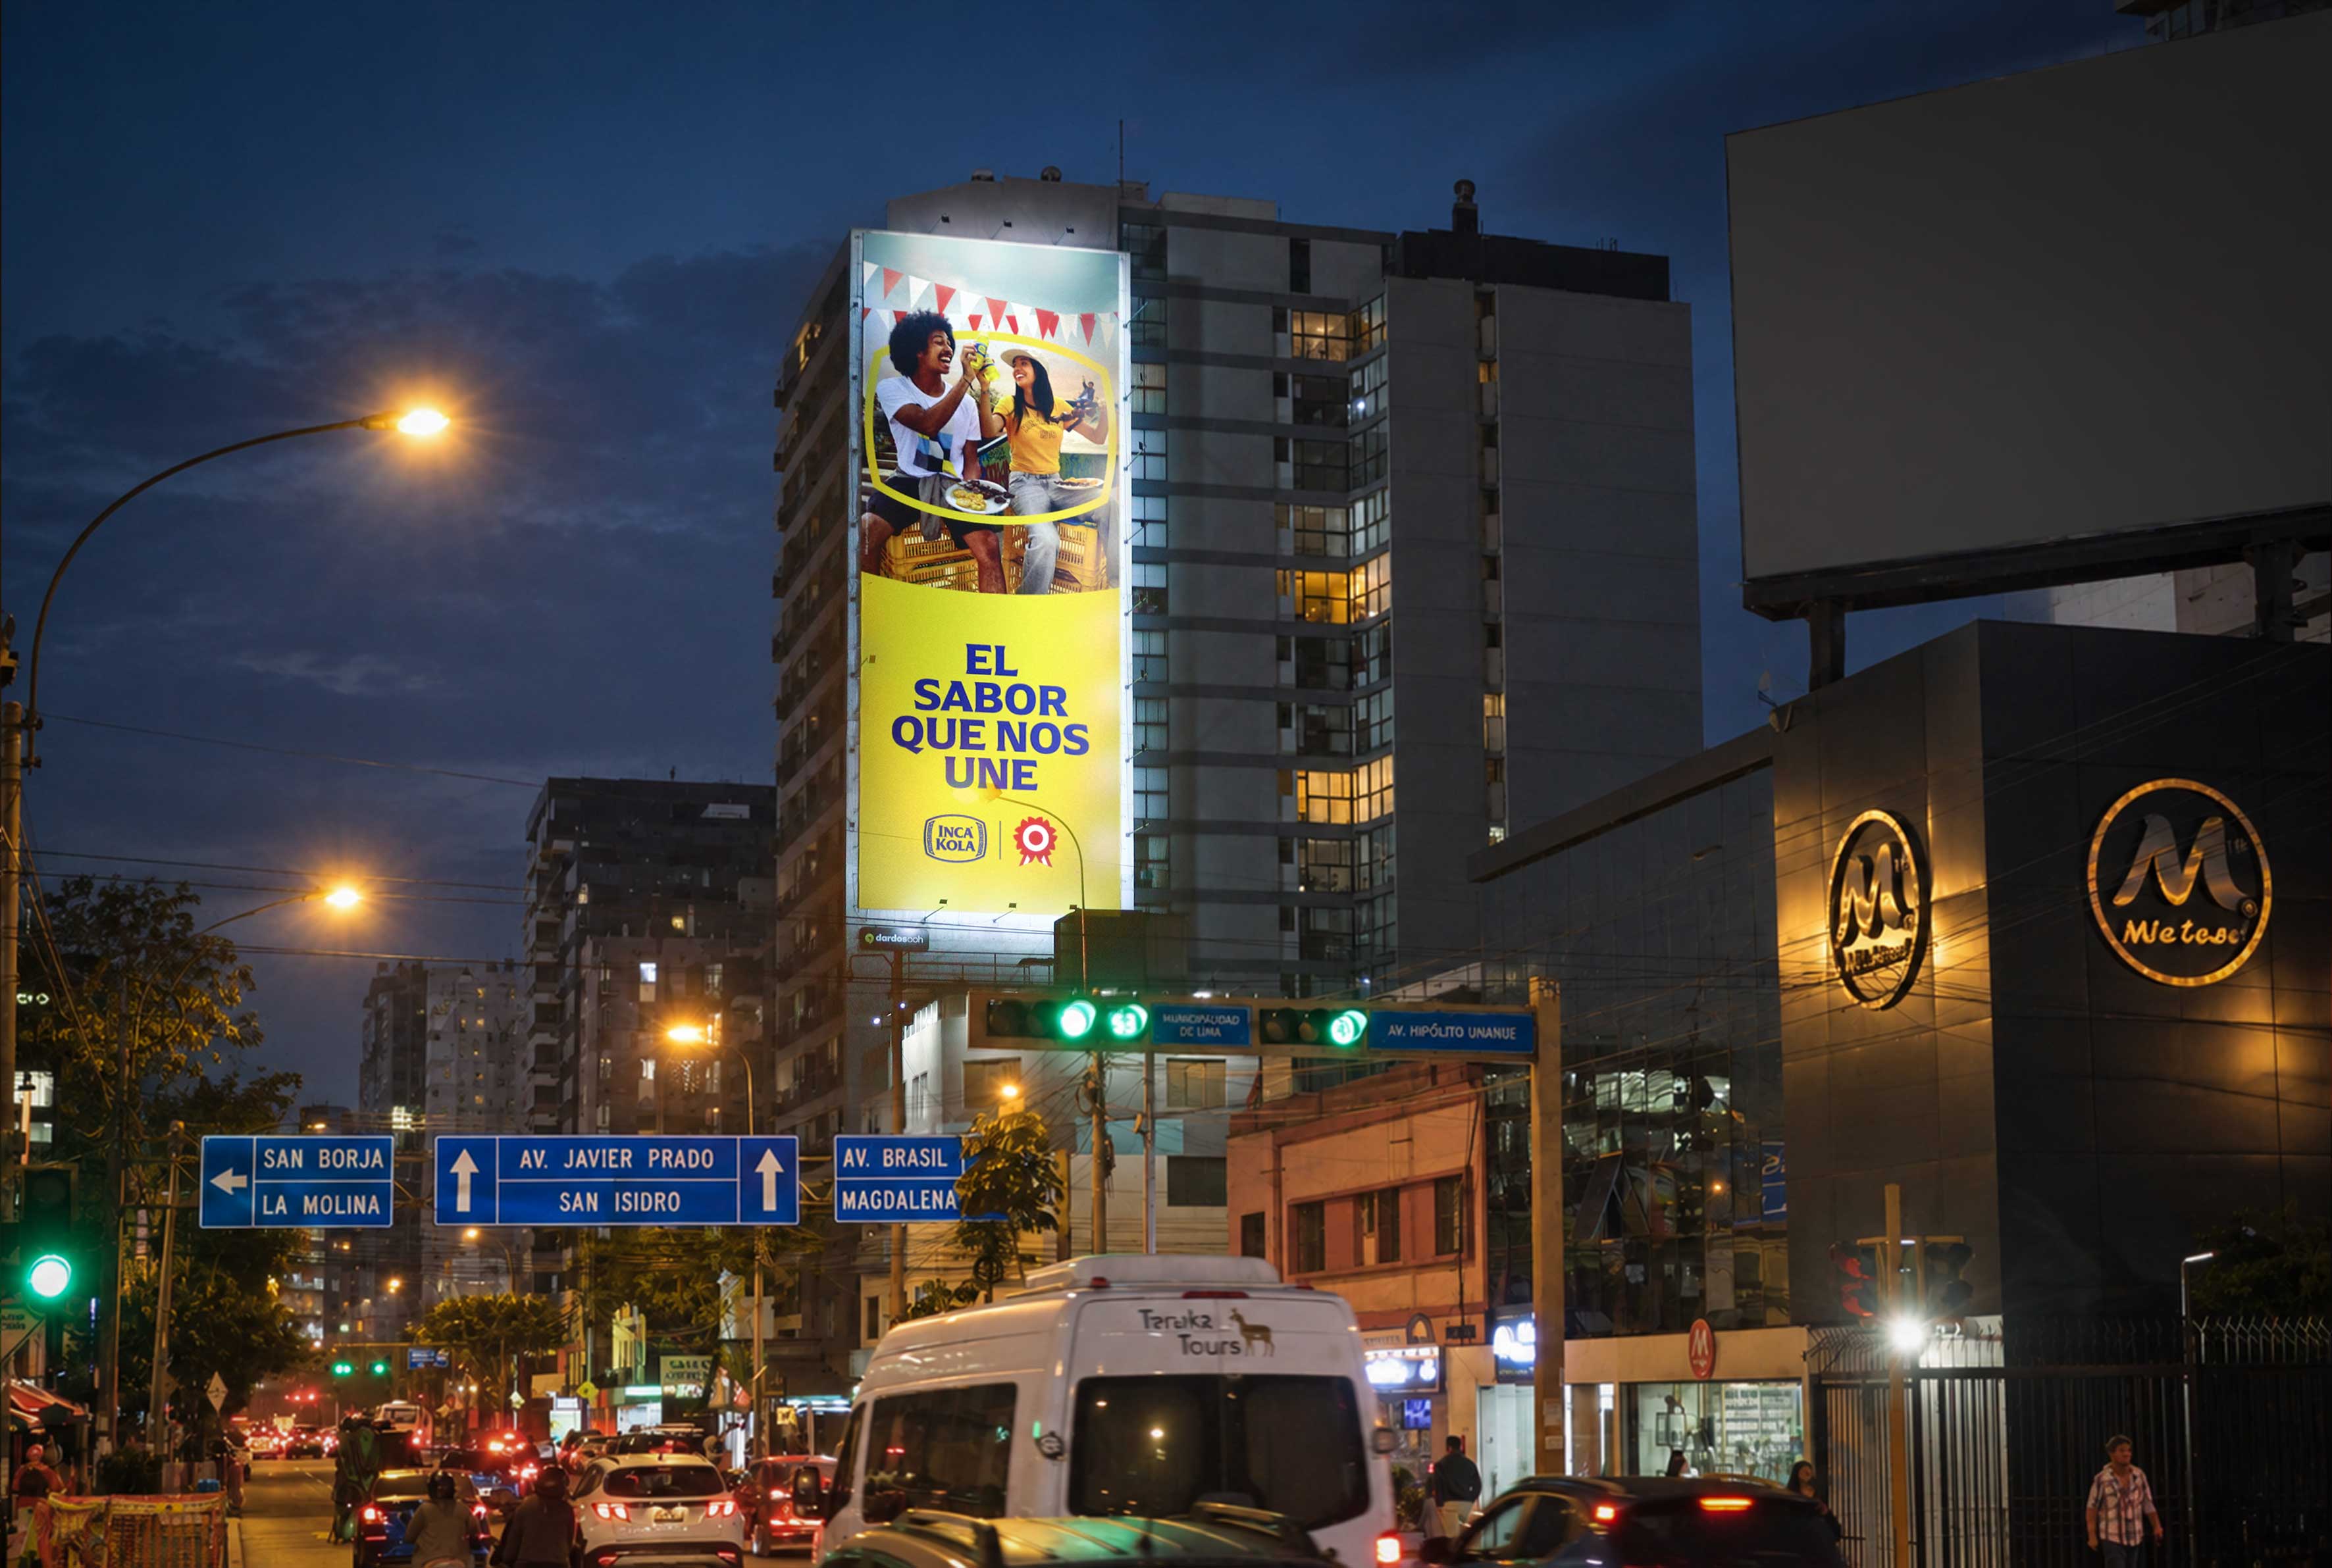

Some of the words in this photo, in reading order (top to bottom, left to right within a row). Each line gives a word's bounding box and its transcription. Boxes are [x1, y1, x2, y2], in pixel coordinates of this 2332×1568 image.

[966, 643, 1018, 677] EL
[914, 678, 1068, 717] SABOR
[891, 715, 986, 754] QUE
[997, 721, 1090, 756] NOS
[945, 755, 1039, 792] UNE
[939, 825, 974, 839] INCA
[935, 838, 975, 852] KOLA
[1179, 1026, 1195, 1037] DE
[1199, 1026, 1222, 1037] LIMA
[1388, 1024, 1406, 1036] AV.
[1409, 1023, 1464, 1038] HIPÓLITO
[1468, 1026, 1516, 1040] UNANUE
[263, 1148, 303, 1169] SAN
[319, 1148, 384, 1169] BORJA
[519, 1150, 549, 1169] AV.
[563, 1148, 633, 1169] JAVIER
[648, 1148, 715, 1169] PRADO
[842, 1148, 870, 1168] AV.
[882, 1148, 948, 1168] BRASIL
[262, 1194, 288, 1215] LA
[303, 1194, 380, 1215] MOLINA
[559, 1191, 599, 1213] SAN
[614, 1191, 681, 1213] ISIDRO
[842, 1189, 958, 1211] MAGDALENA
[1178, 1333, 1241, 1356] Tours
